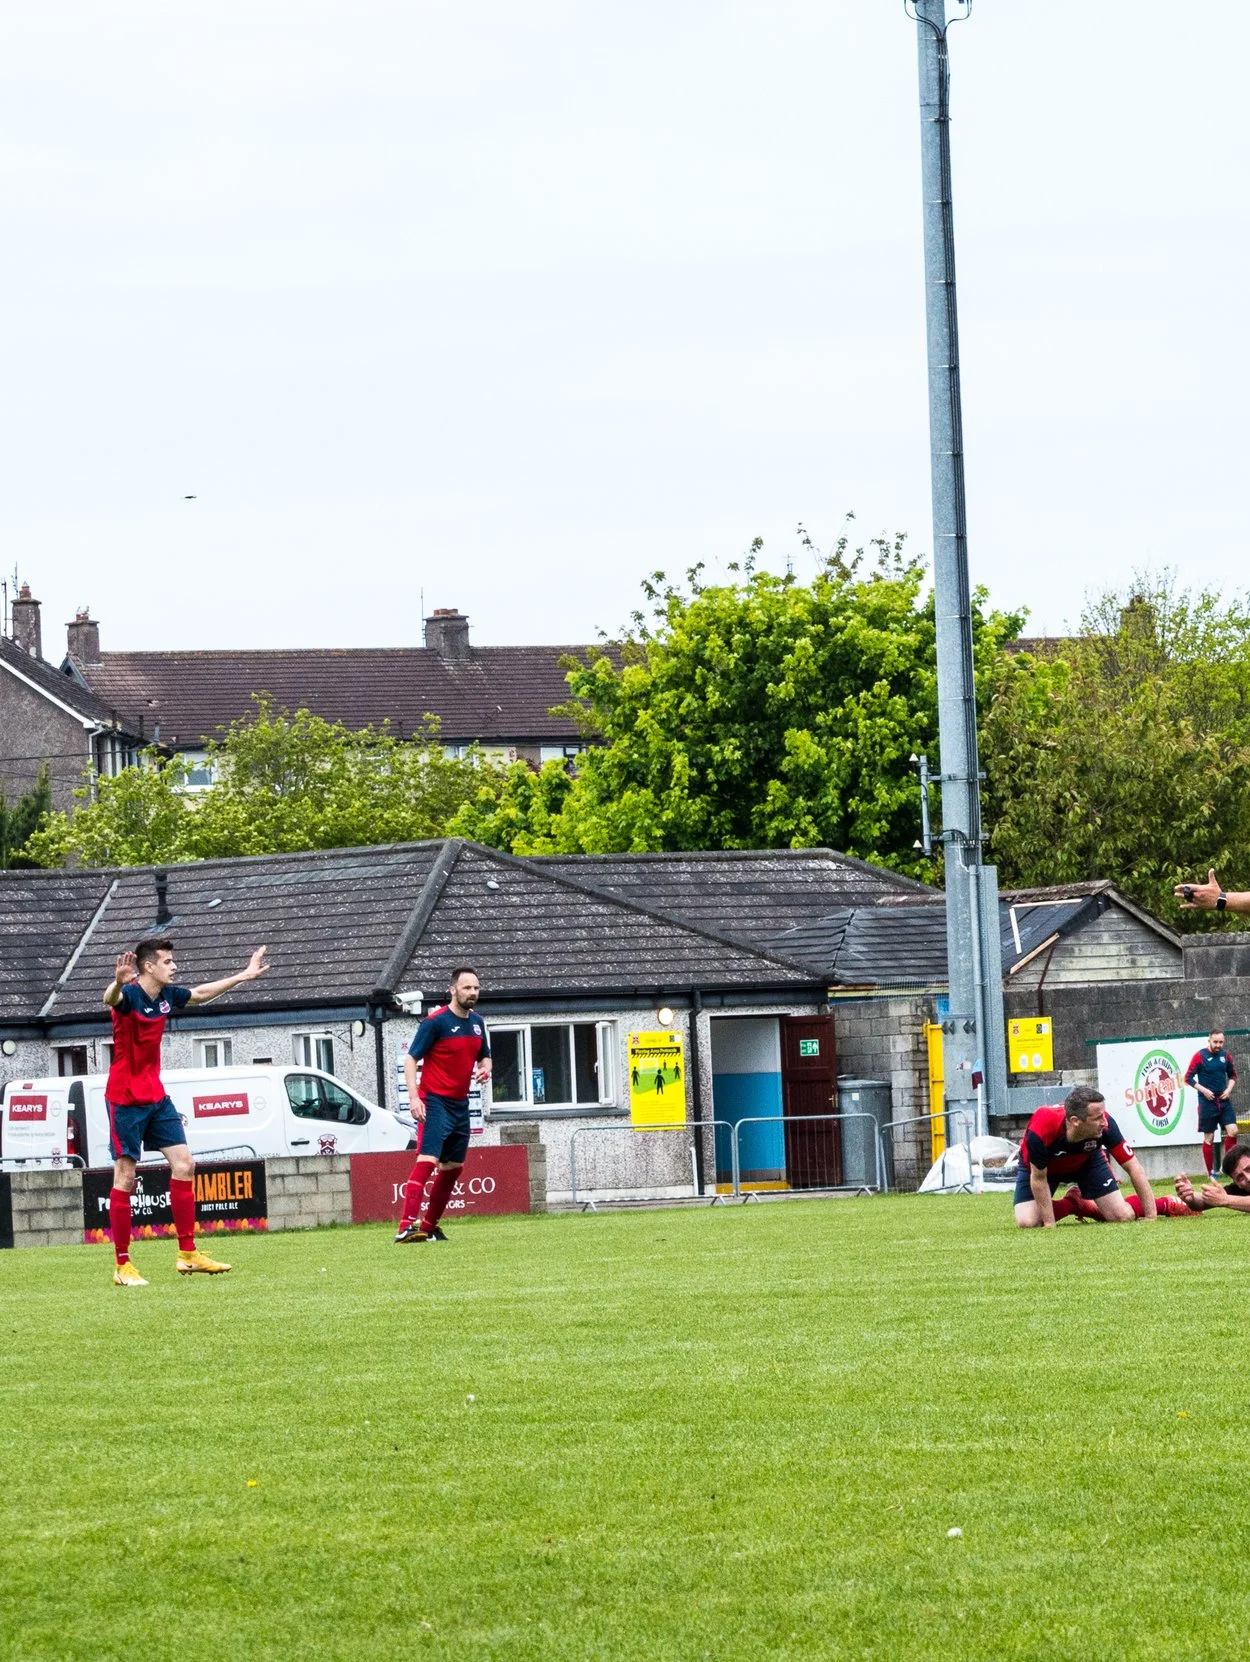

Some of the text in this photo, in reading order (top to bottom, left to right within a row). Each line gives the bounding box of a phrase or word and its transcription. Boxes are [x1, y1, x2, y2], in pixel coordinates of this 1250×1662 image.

[1141, 1062, 1153, 1077] FISH
[1158, 1058, 1174, 1074] CHIPS
[1124, 1072, 1184, 1107] Sorrent
[12, 1104, 43, 1112] KEARYS
[198, 1100, 243, 1111] KEARYS
[1152, 1118, 1170, 1127] COBH
[392, 1177, 496, 1204] JOC & CO
[98, 1192, 171, 1212] PORHOUSE
[215, 1202, 228, 1211] PALE
[229, 1201, 239, 1210] ALE
